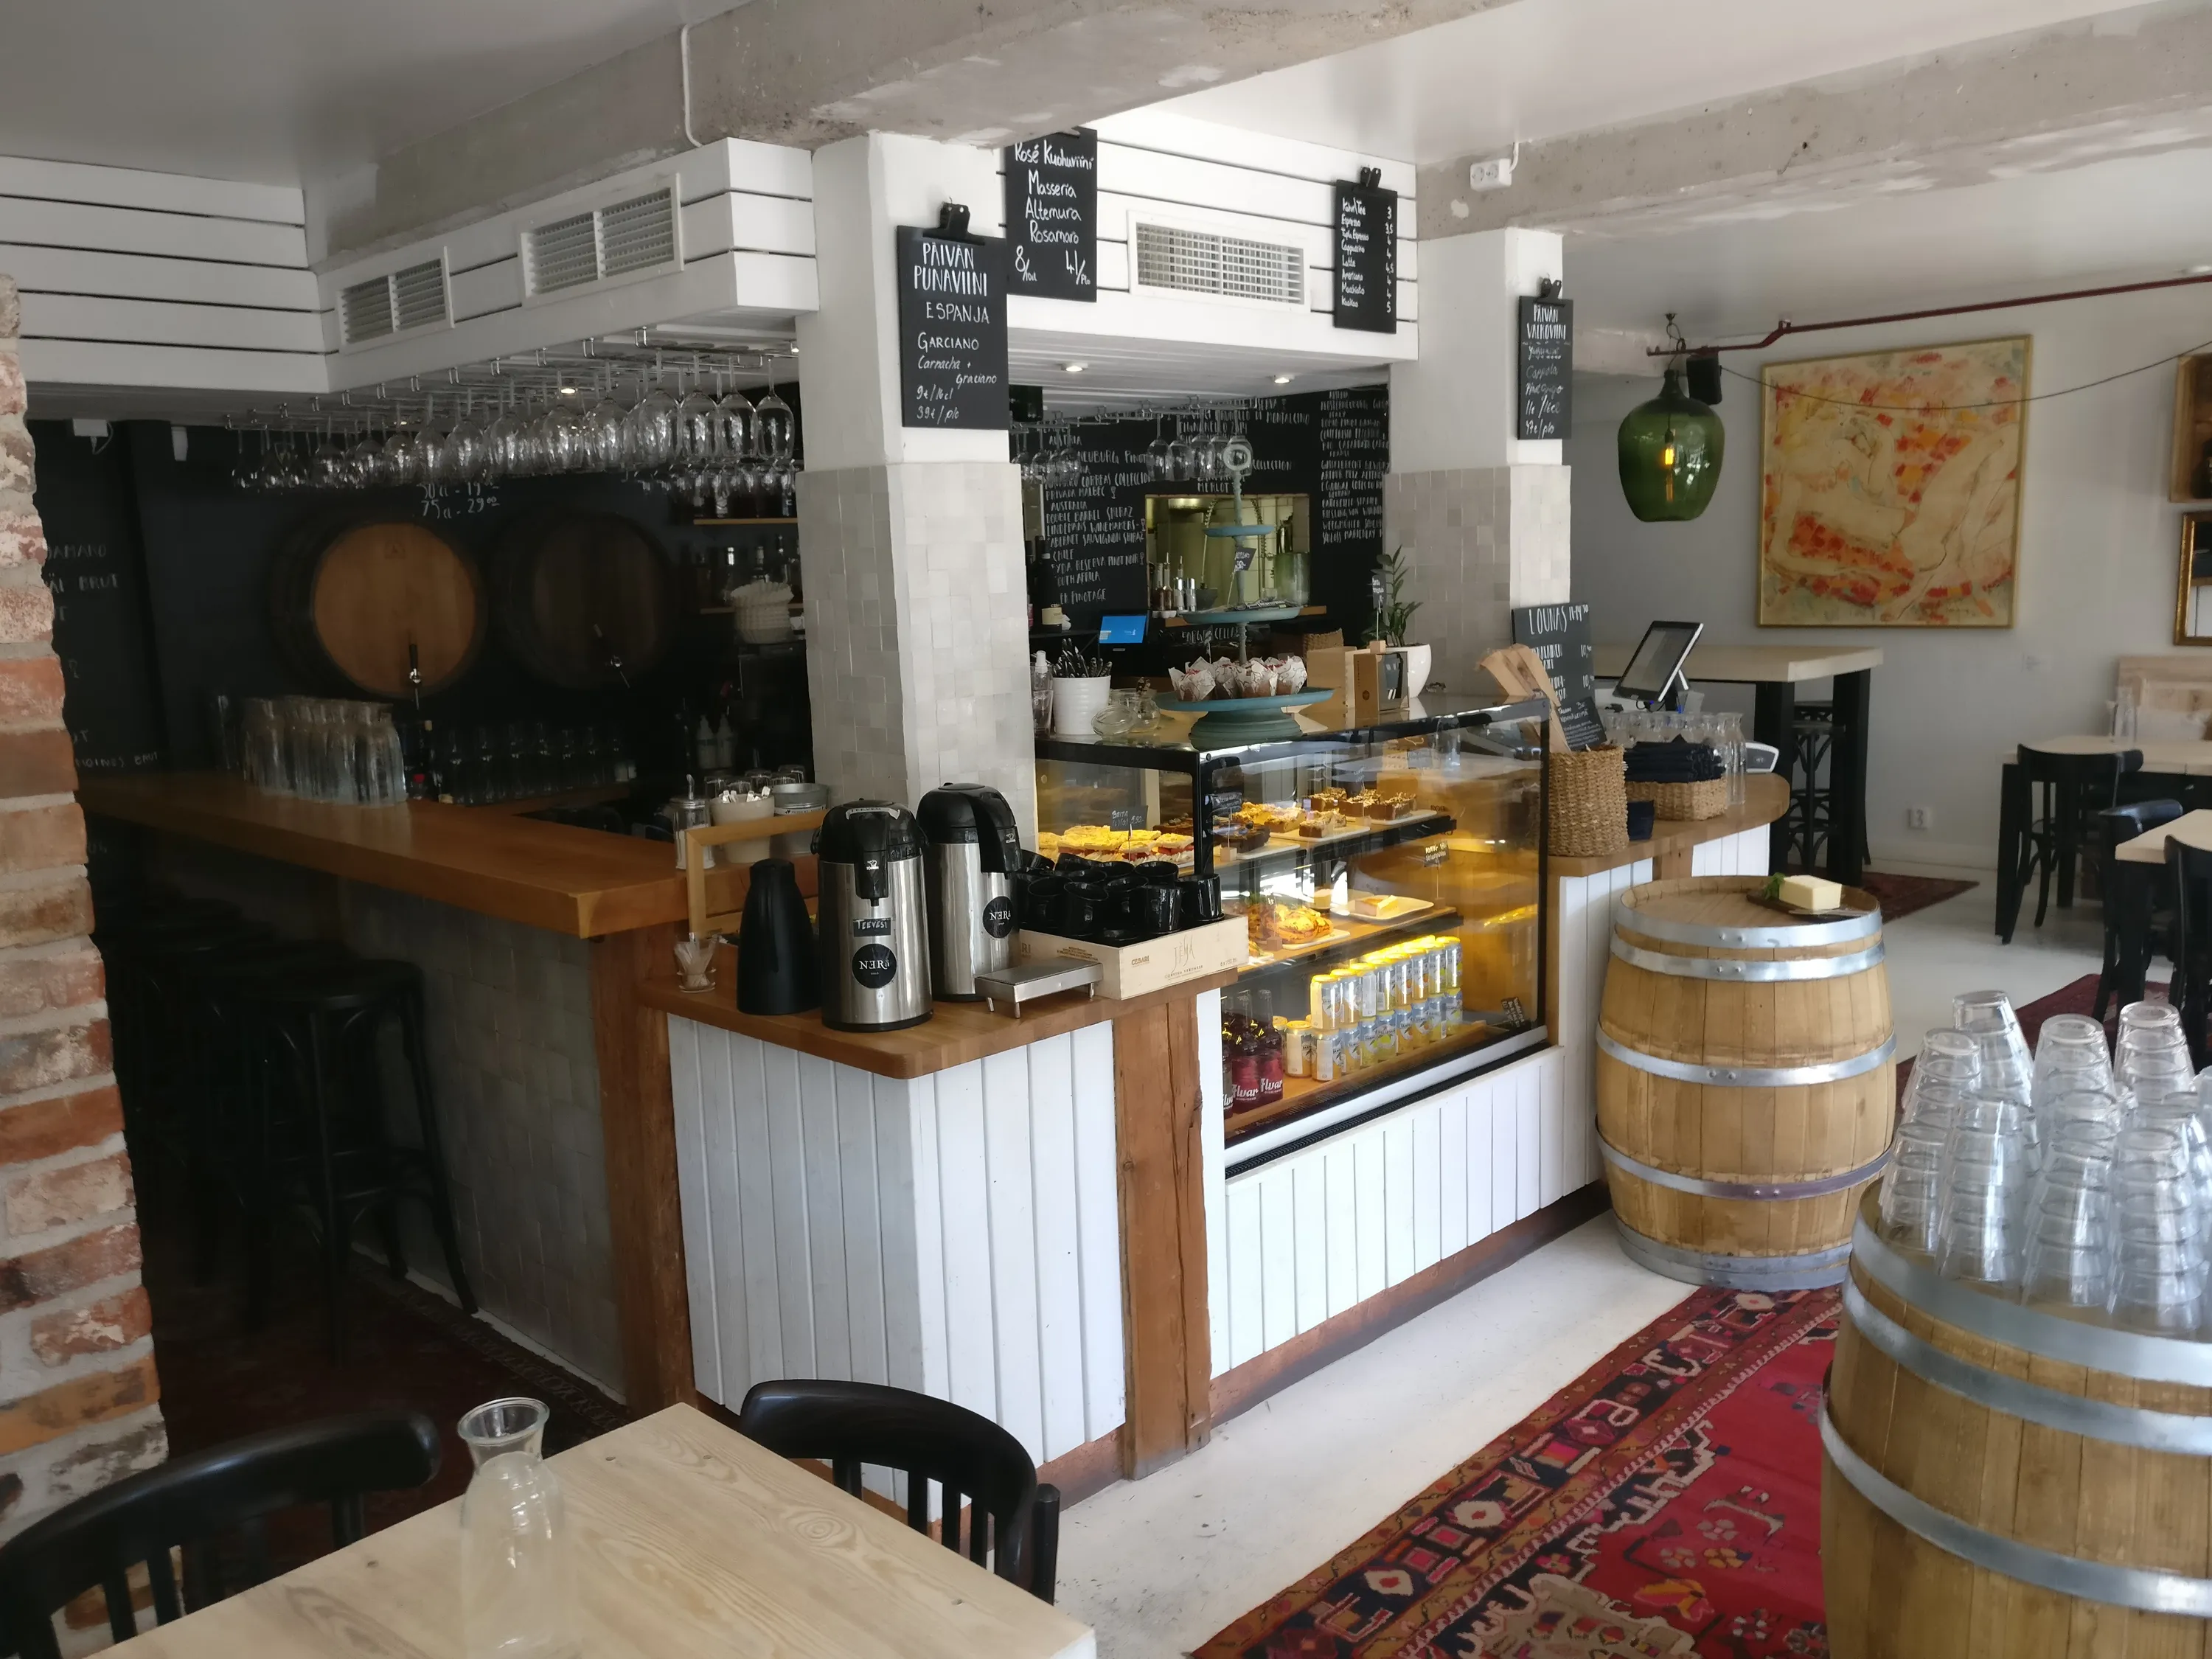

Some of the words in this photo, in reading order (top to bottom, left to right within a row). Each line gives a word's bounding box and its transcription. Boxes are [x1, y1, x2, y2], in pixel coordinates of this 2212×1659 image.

[1014, 142, 1040, 164] Rosé
[1043, 139, 1094, 170] Kuohuviini
[1028, 169, 1077, 198] Masseria
[1025, 196, 1082, 221] Altemura
[1386, 206, 1392, 220] 3
[1029, 220, 1079, 244] Rosamaro
[922, 242, 975, 270] PÄIVÄN
[1342, 254, 1356, 267] Latte
[1386, 248, 1392, 259] 4
[914, 265, 988, 297] PUNAVIINI
[1386, 275, 1392, 285] 4
[1386, 288, 1392, 299] 4
[925, 303, 990, 324] ESPANJA
[1386, 301, 1391, 313] 5
[1534, 304, 1559, 323] PÄIVÄN
[1526, 322, 1566, 340] VALKOVIINI
[917, 331, 980, 353] GARCIANO
[1197, 482, 1229, 493] MERLOT
[1047, 534, 1079, 548] ABERNET
[78, 574, 119, 591] BRUT
[1528, 605, 1568, 635] LOUNAS
[1131, 955, 1150, 965] CESARI
